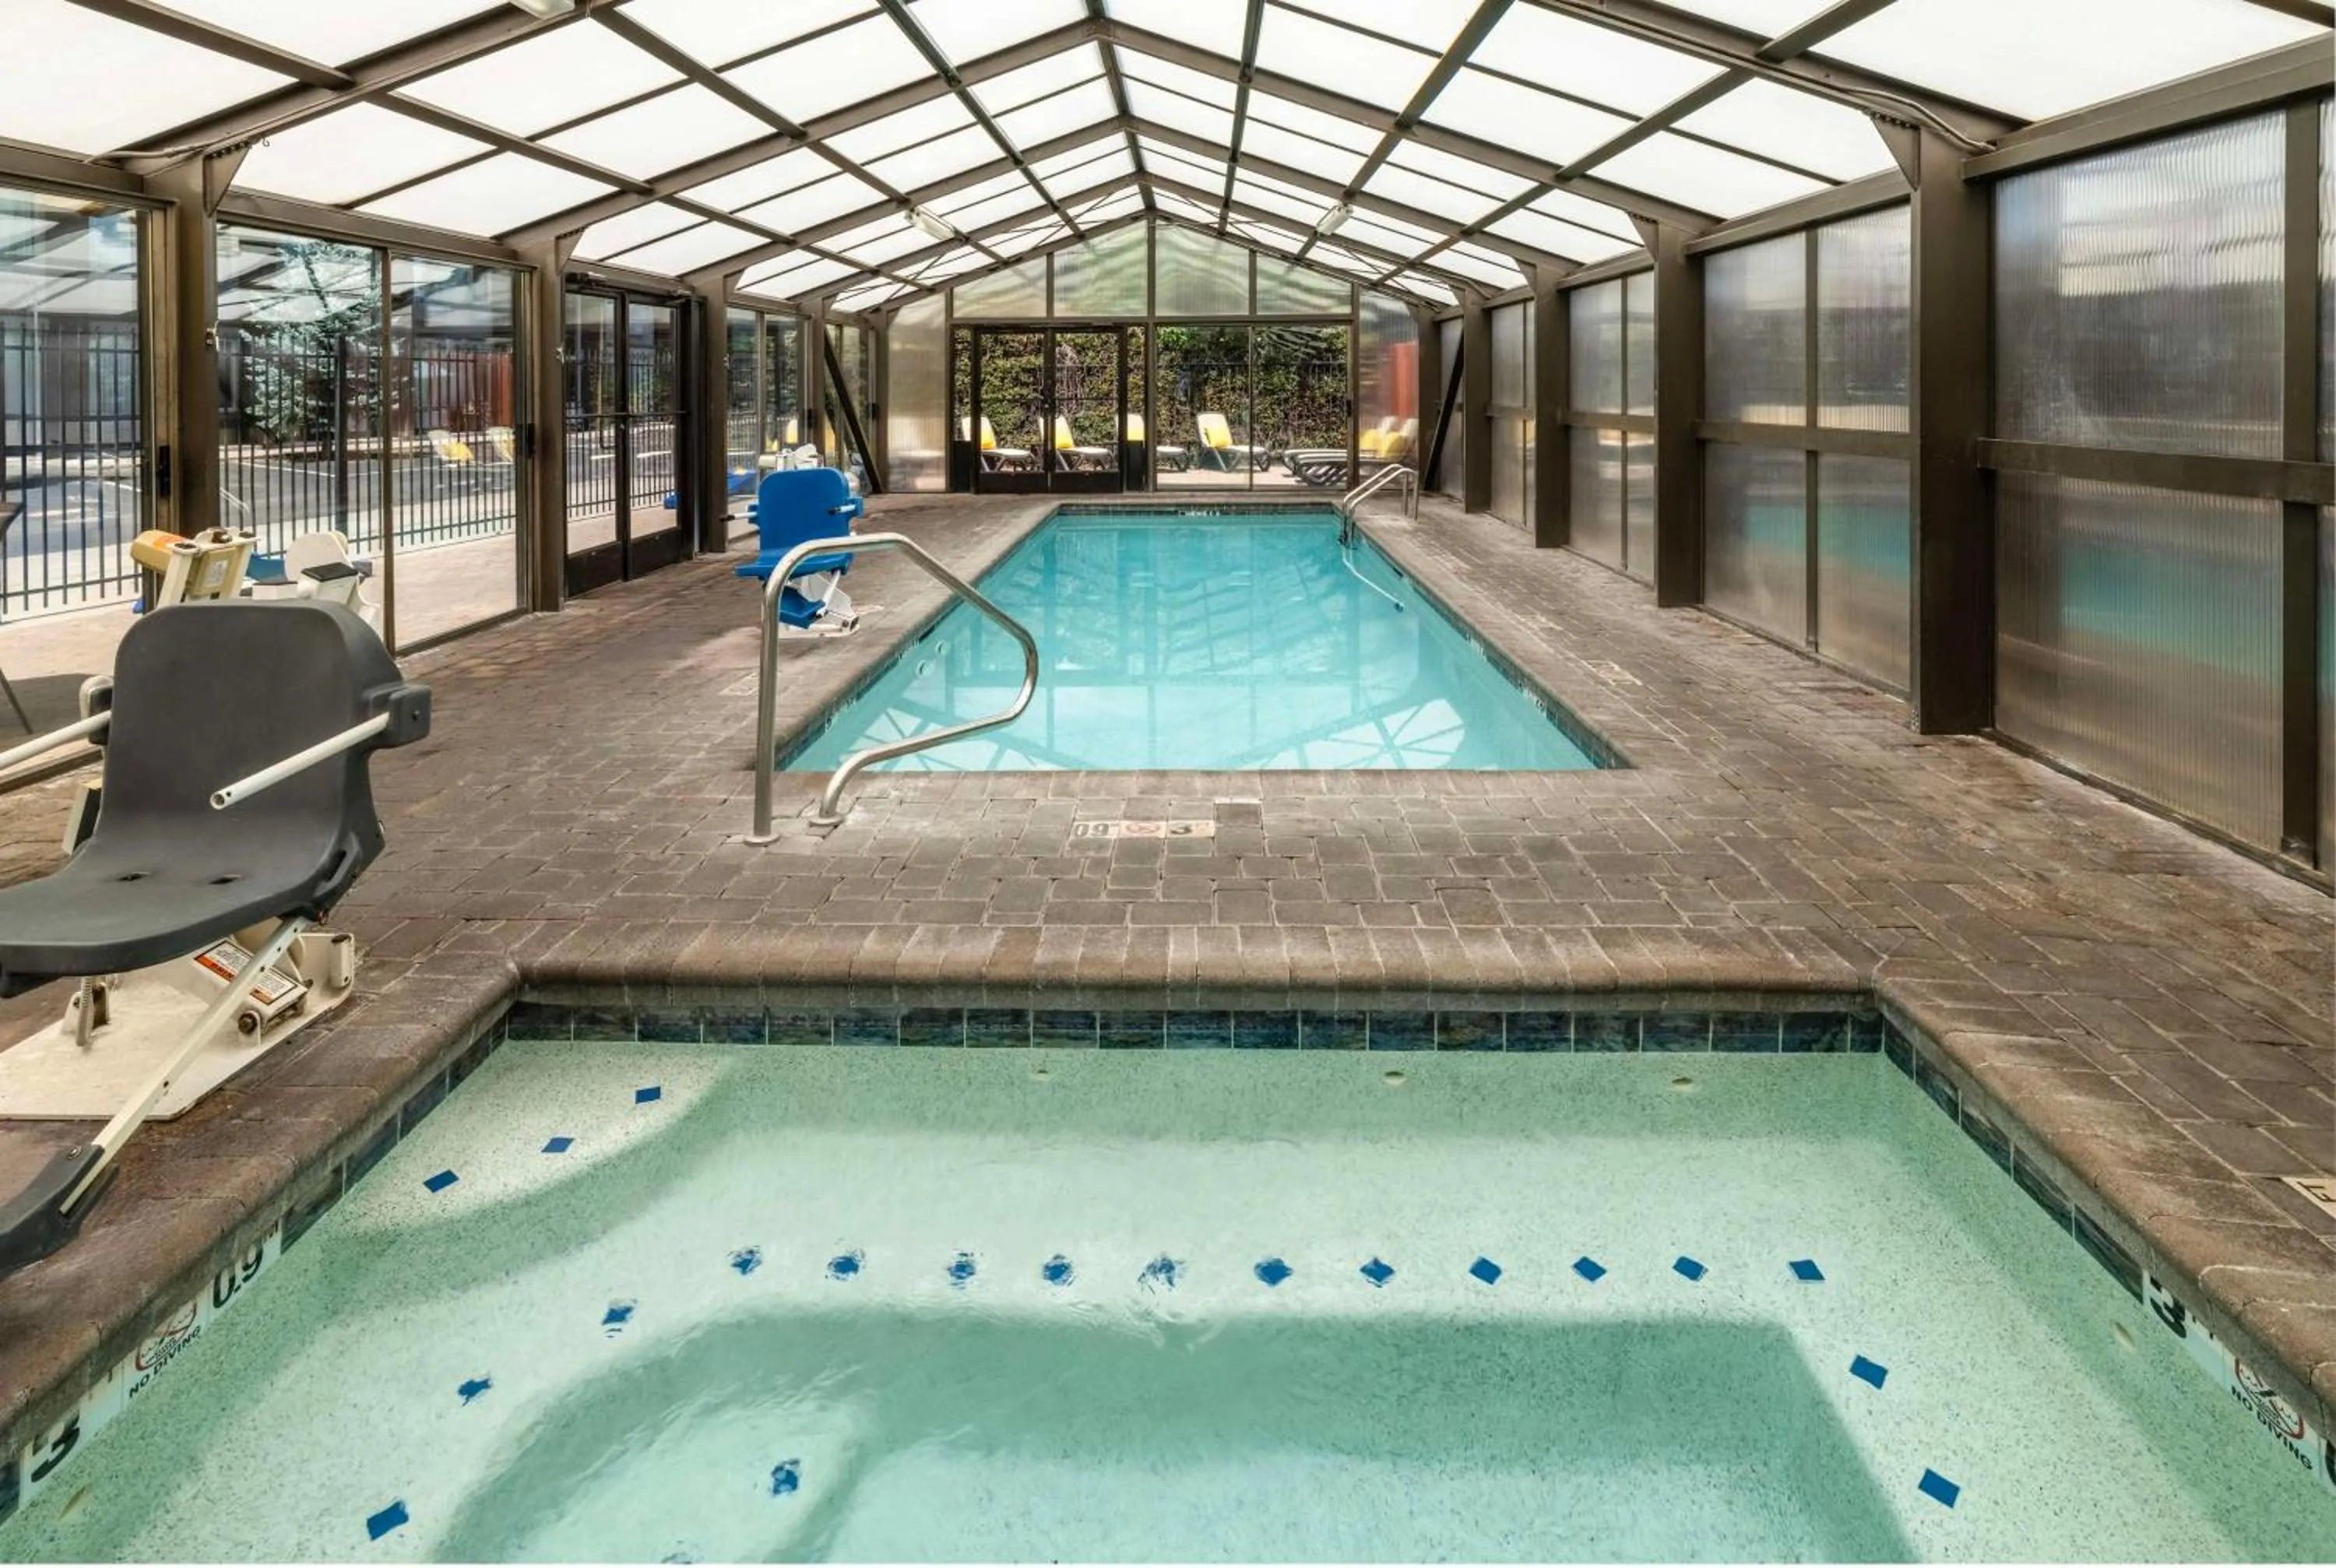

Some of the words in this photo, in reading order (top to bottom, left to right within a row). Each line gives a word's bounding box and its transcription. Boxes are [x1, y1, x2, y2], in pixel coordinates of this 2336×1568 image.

[2149, 1275, 2187, 1339] 3
[128, 1373, 150, 1399] NO
[153, 1324, 201, 1376] DIVING
[30, 1408, 81, 1483] 3
[2231, 1385, 2253, 1412] NO
[2257, 1409, 2313, 1471] DIVING
